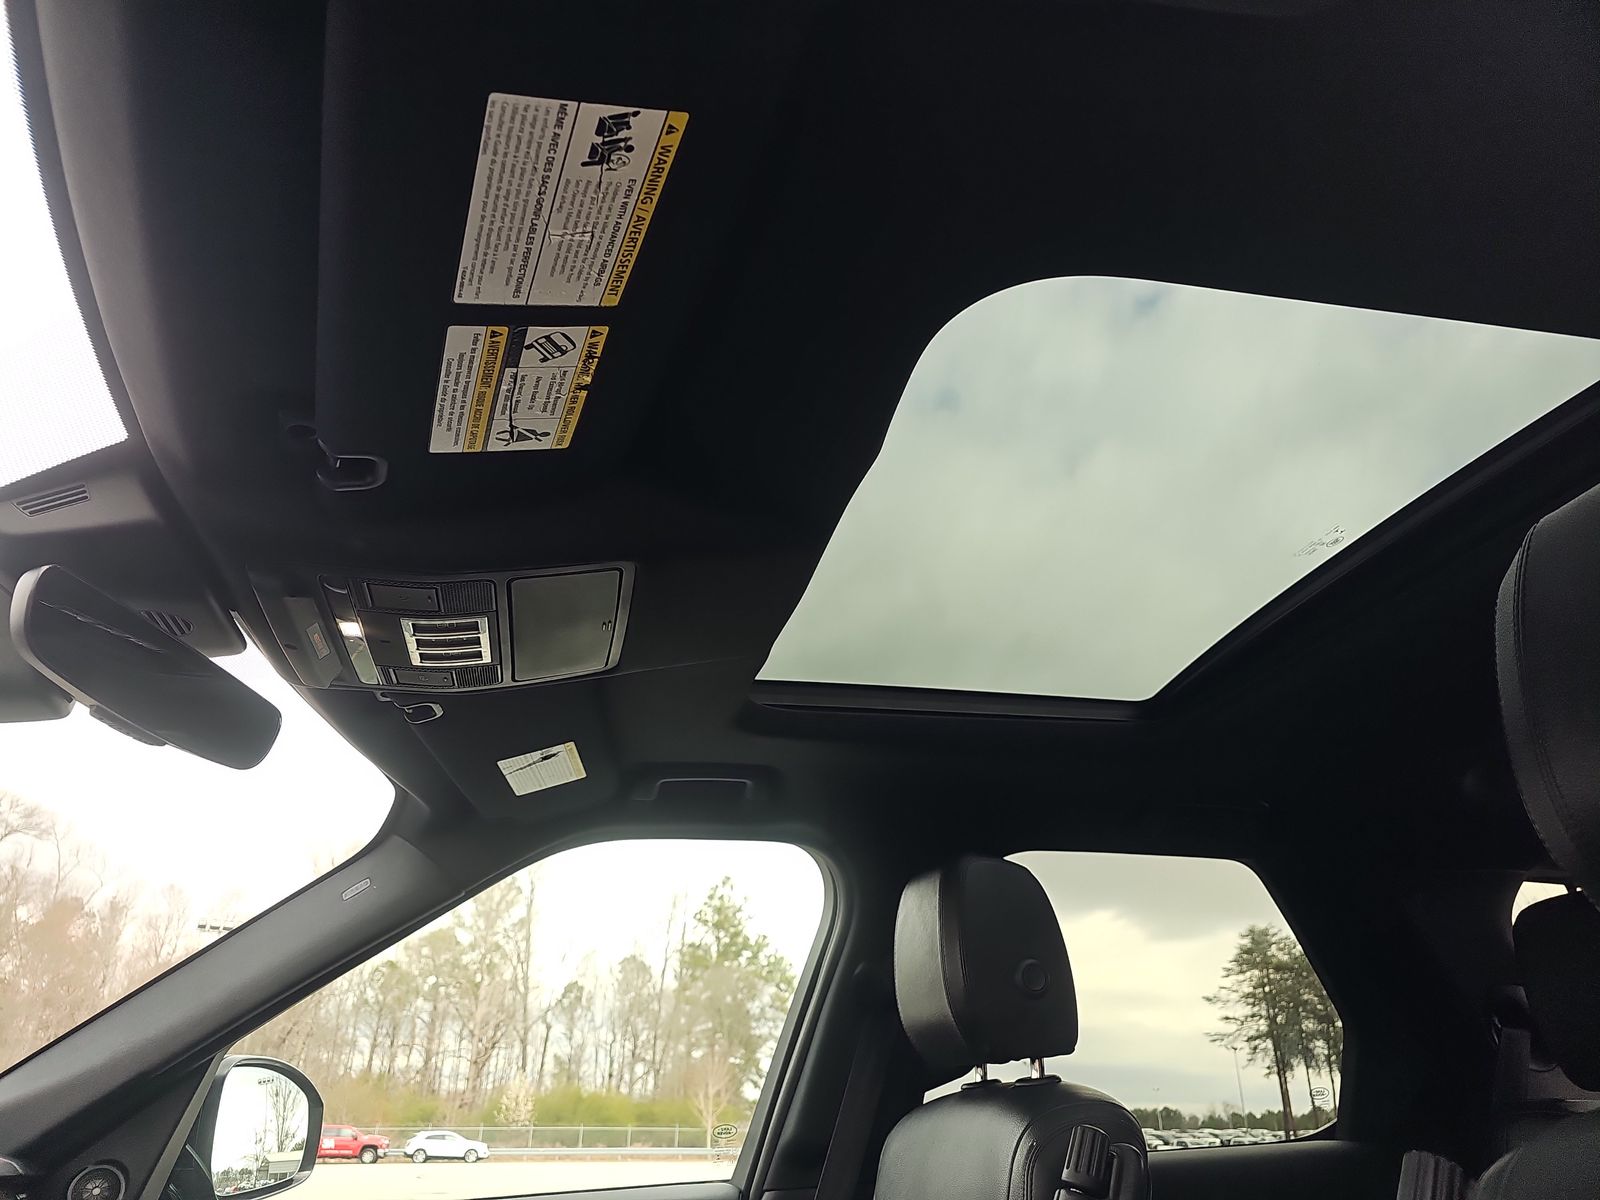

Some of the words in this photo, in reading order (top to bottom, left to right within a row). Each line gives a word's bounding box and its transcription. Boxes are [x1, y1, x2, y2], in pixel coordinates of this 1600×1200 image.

[547, 131, 561, 154] AVEC
[543, 156, 555, 172] DES
[640, 143, 673, 204] WARNING
[622, 178, 636, 198] EVEN
[615, 200, 629, 219] WITH
[602, 220, 622, 257] ADVANCED
[606, 214, 646, 296] AVERTISSEMENT
[593, 258, 609, 286] AIRBAGS
[558, 405, 576, 434] ROLLOVER
